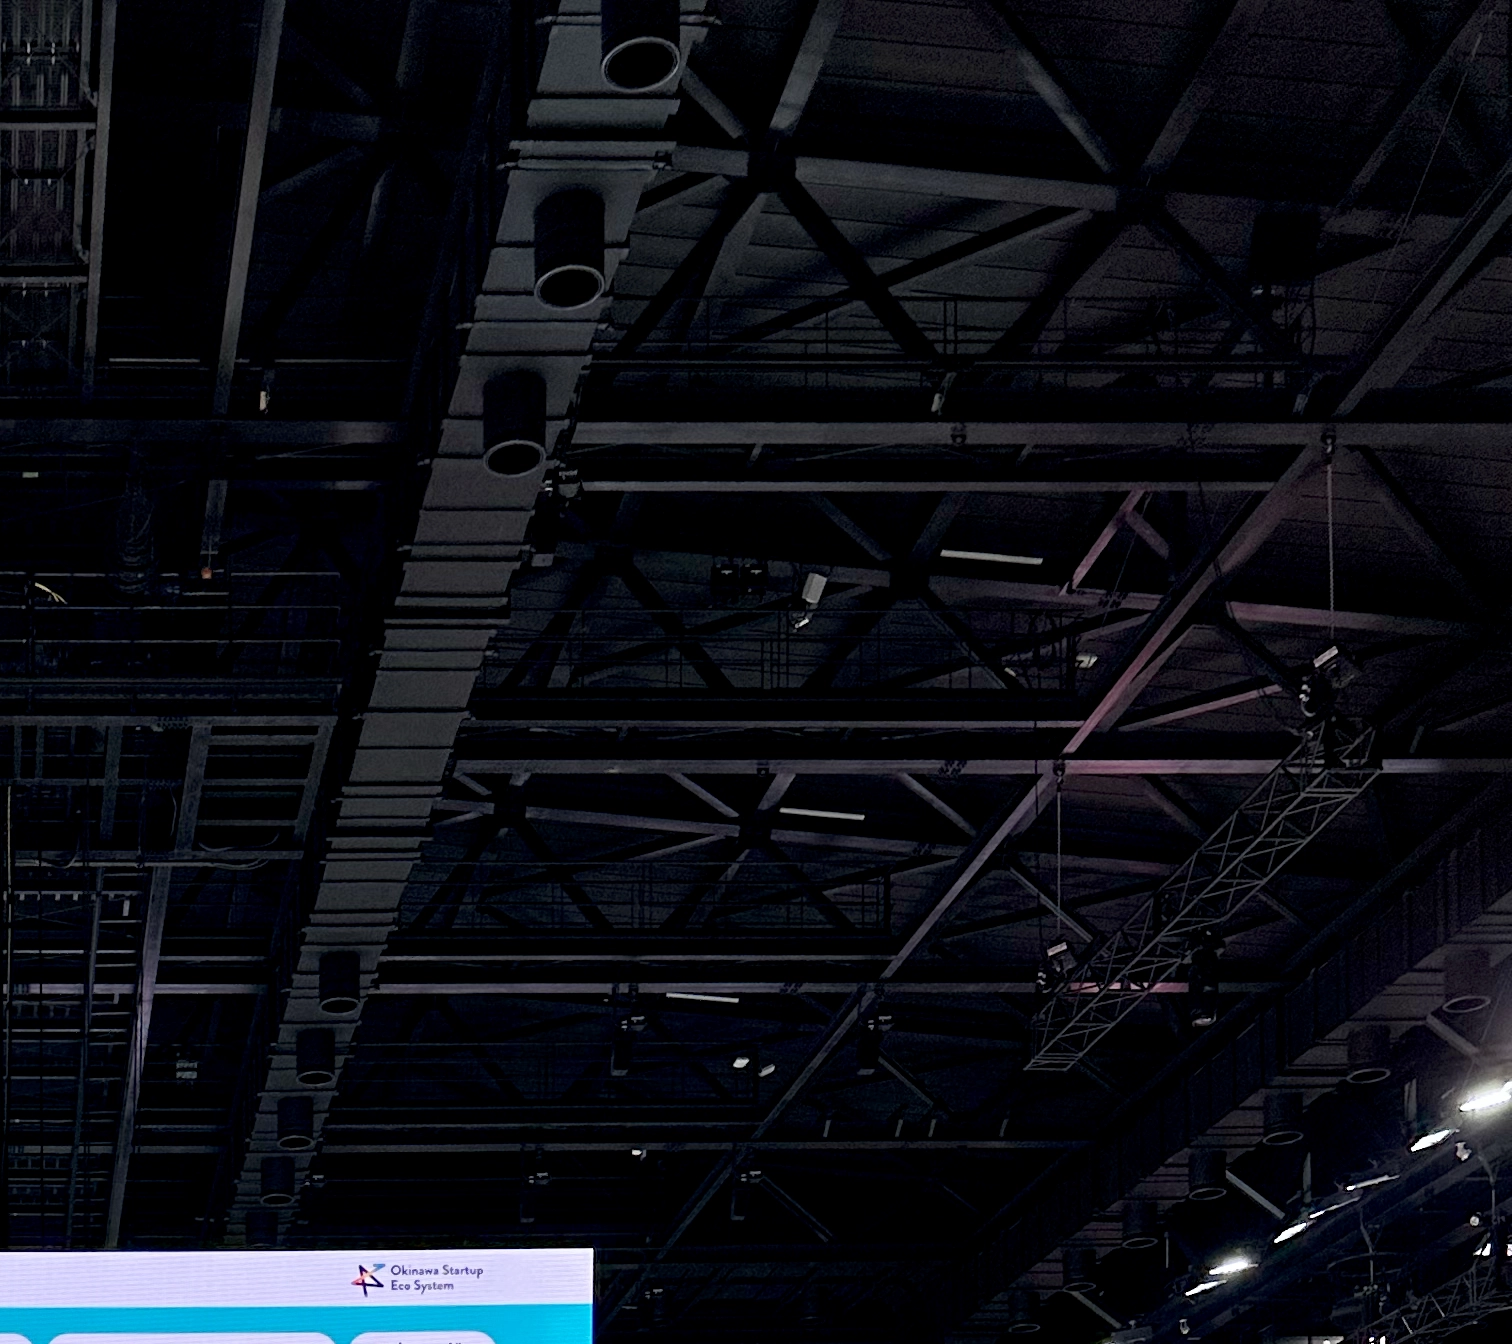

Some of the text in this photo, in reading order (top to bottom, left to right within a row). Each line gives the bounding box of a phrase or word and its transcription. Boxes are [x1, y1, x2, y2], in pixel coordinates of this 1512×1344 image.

[391, 1265, 484, 1279] Okinawa Startup
[391, 1280, 455, 1294] Eco System
